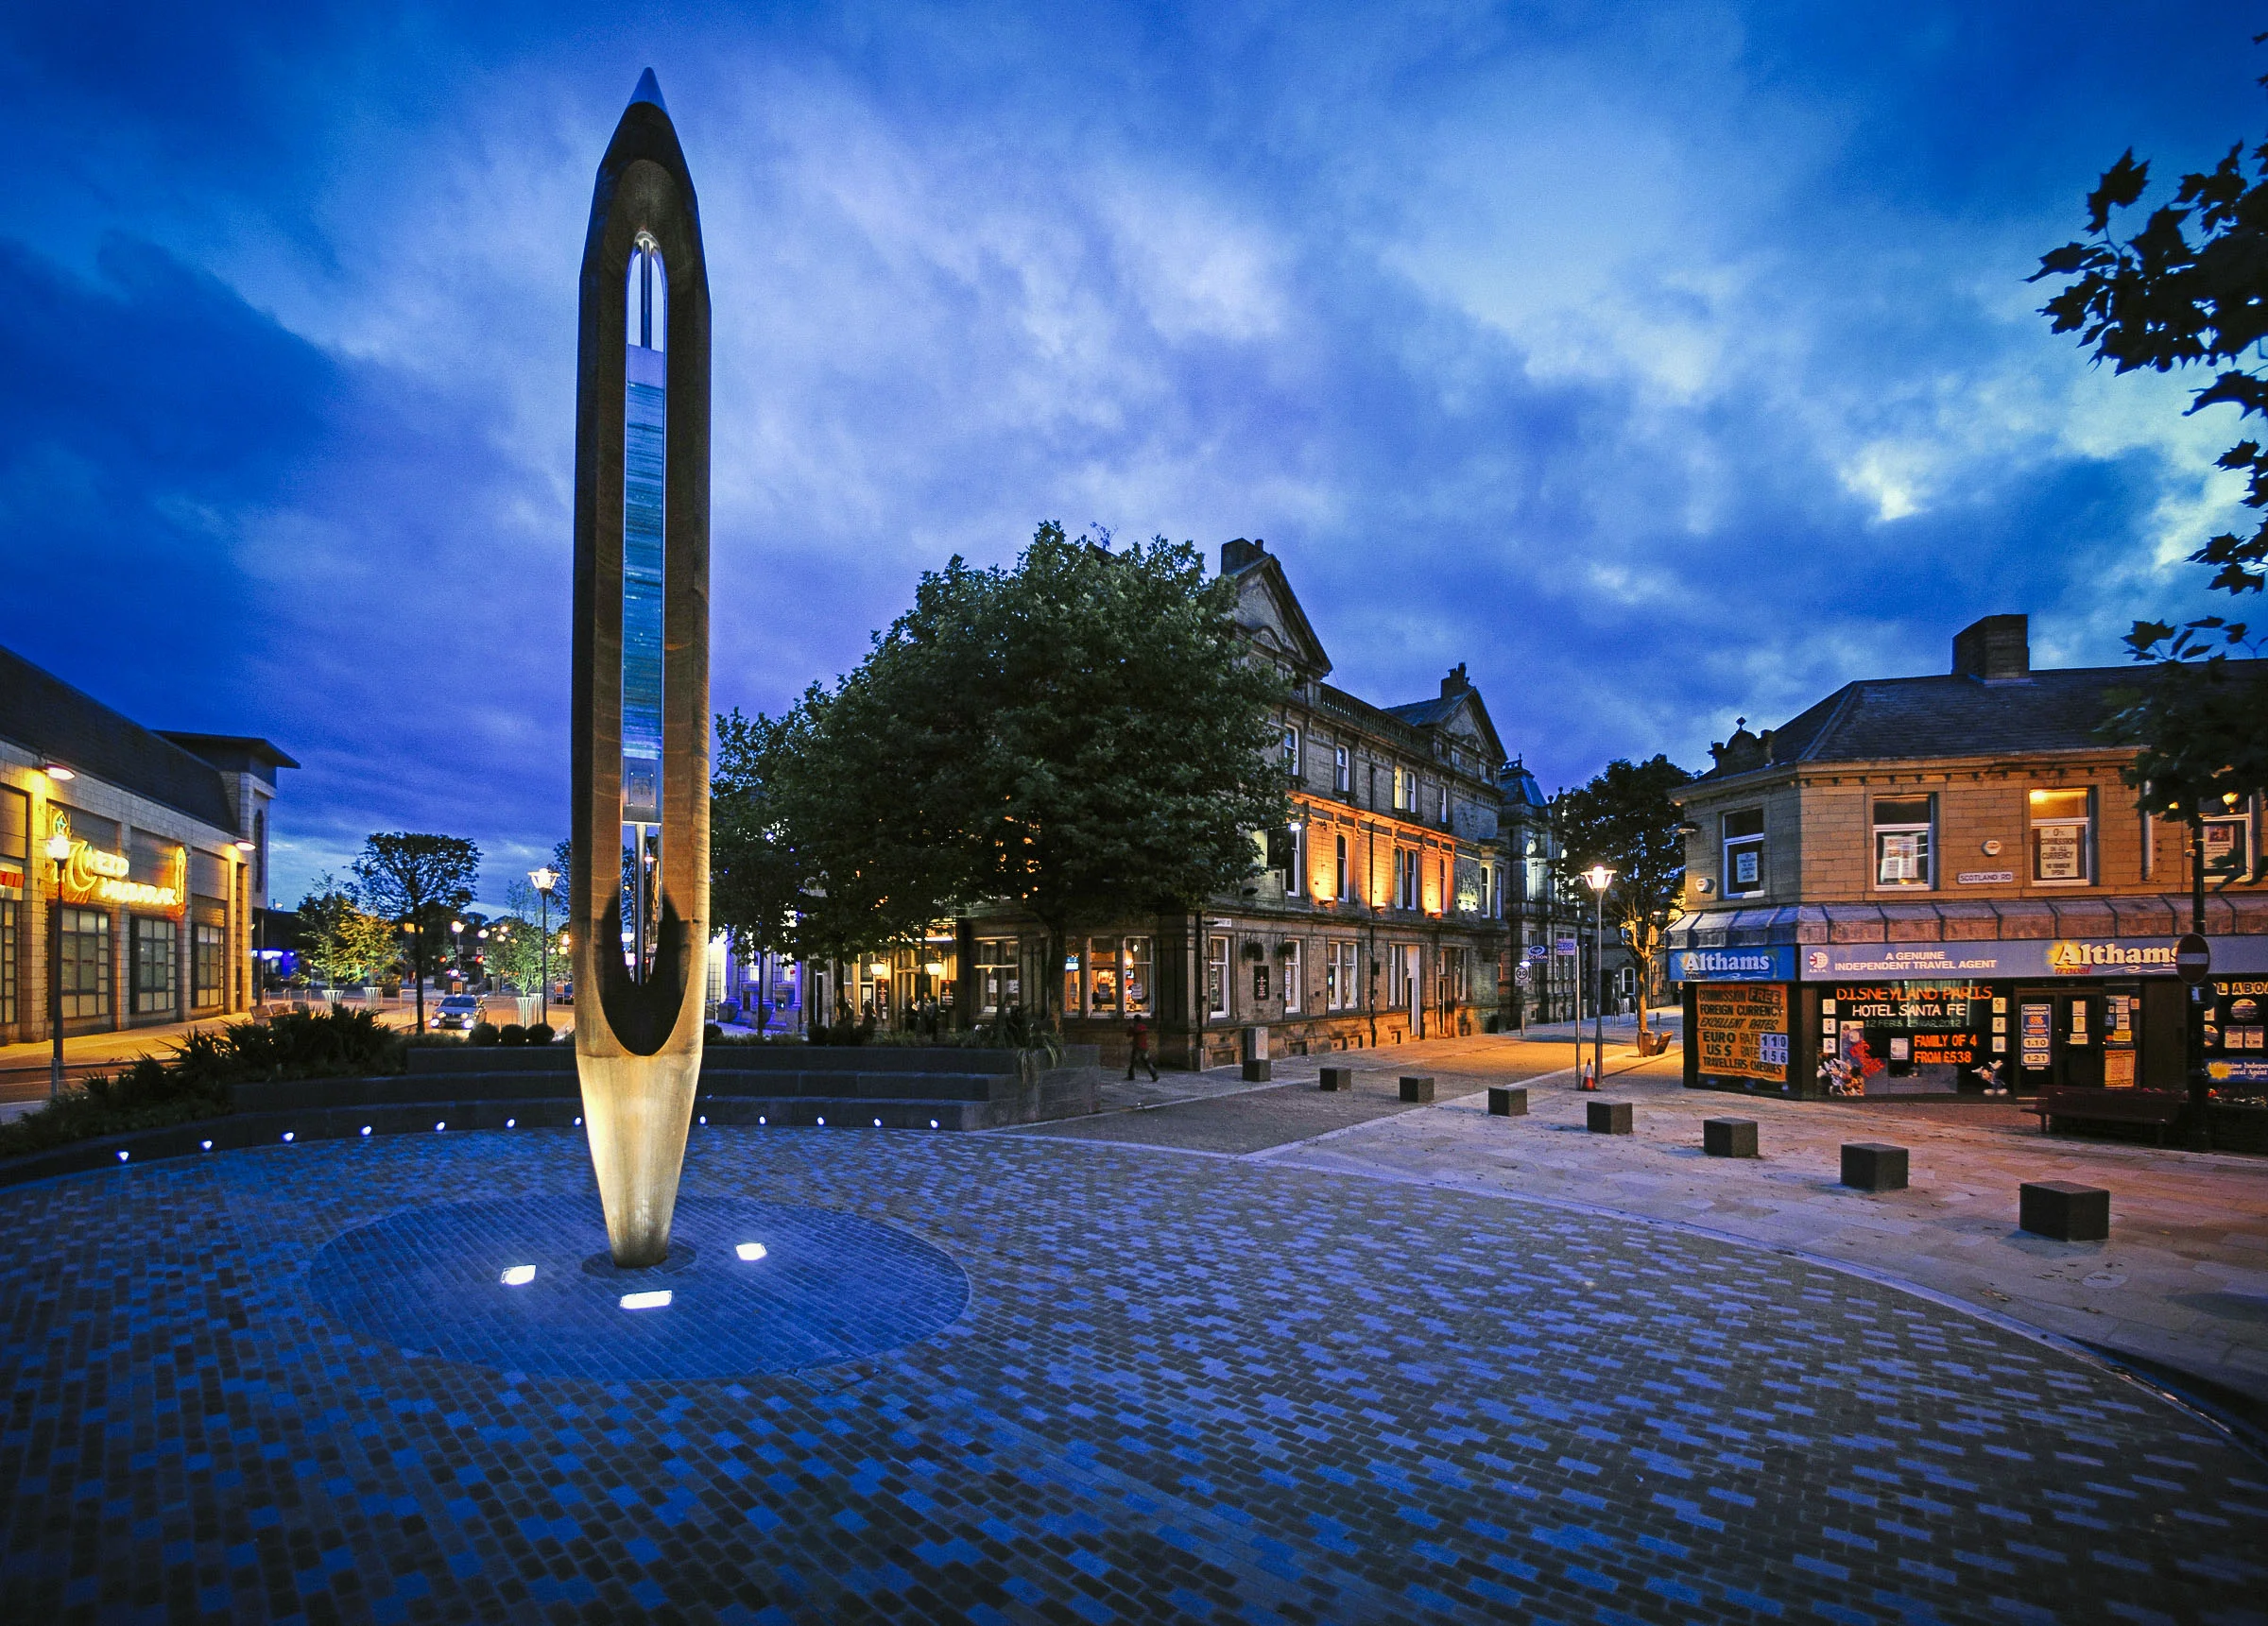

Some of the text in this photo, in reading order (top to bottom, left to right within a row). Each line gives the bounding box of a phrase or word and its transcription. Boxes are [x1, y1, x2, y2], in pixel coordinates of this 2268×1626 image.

[1684, 951, 1770, 971] Althams
[1884, 951, 1945, 961] A GENUINE
[1834, 959, 1997, 971] INDEPENDENT TRAVEL AGENT
[2054, 964, 2092, 975] travel
[1749, 988, 1780, 1003] FREE
[1836, 985, 1993, 1001] DISNEYLAND PARIS
[1700, 1004, 1784, 1017] FOREIGN CURRENCY
[1852, 1003, 1967, 1018] HOTEL SANTA FE
[1700, 1017, 1779, 1030] EXCELLENT RATES
[1703, 1031, 1736, 1043] EURO
[1740, 1033, 1761, 1046] RATE
[1914, 1035, 1978, 1048] FAMILY OF 4
[1707, 1044, 1721, 1055] US
[1741, 1046, 1761, 1058] RATE
[1914, 1051, 1972, 1064] FROM £538
[1703, 1056, 1782, 1074] TRAVELLERS CHEQUES
